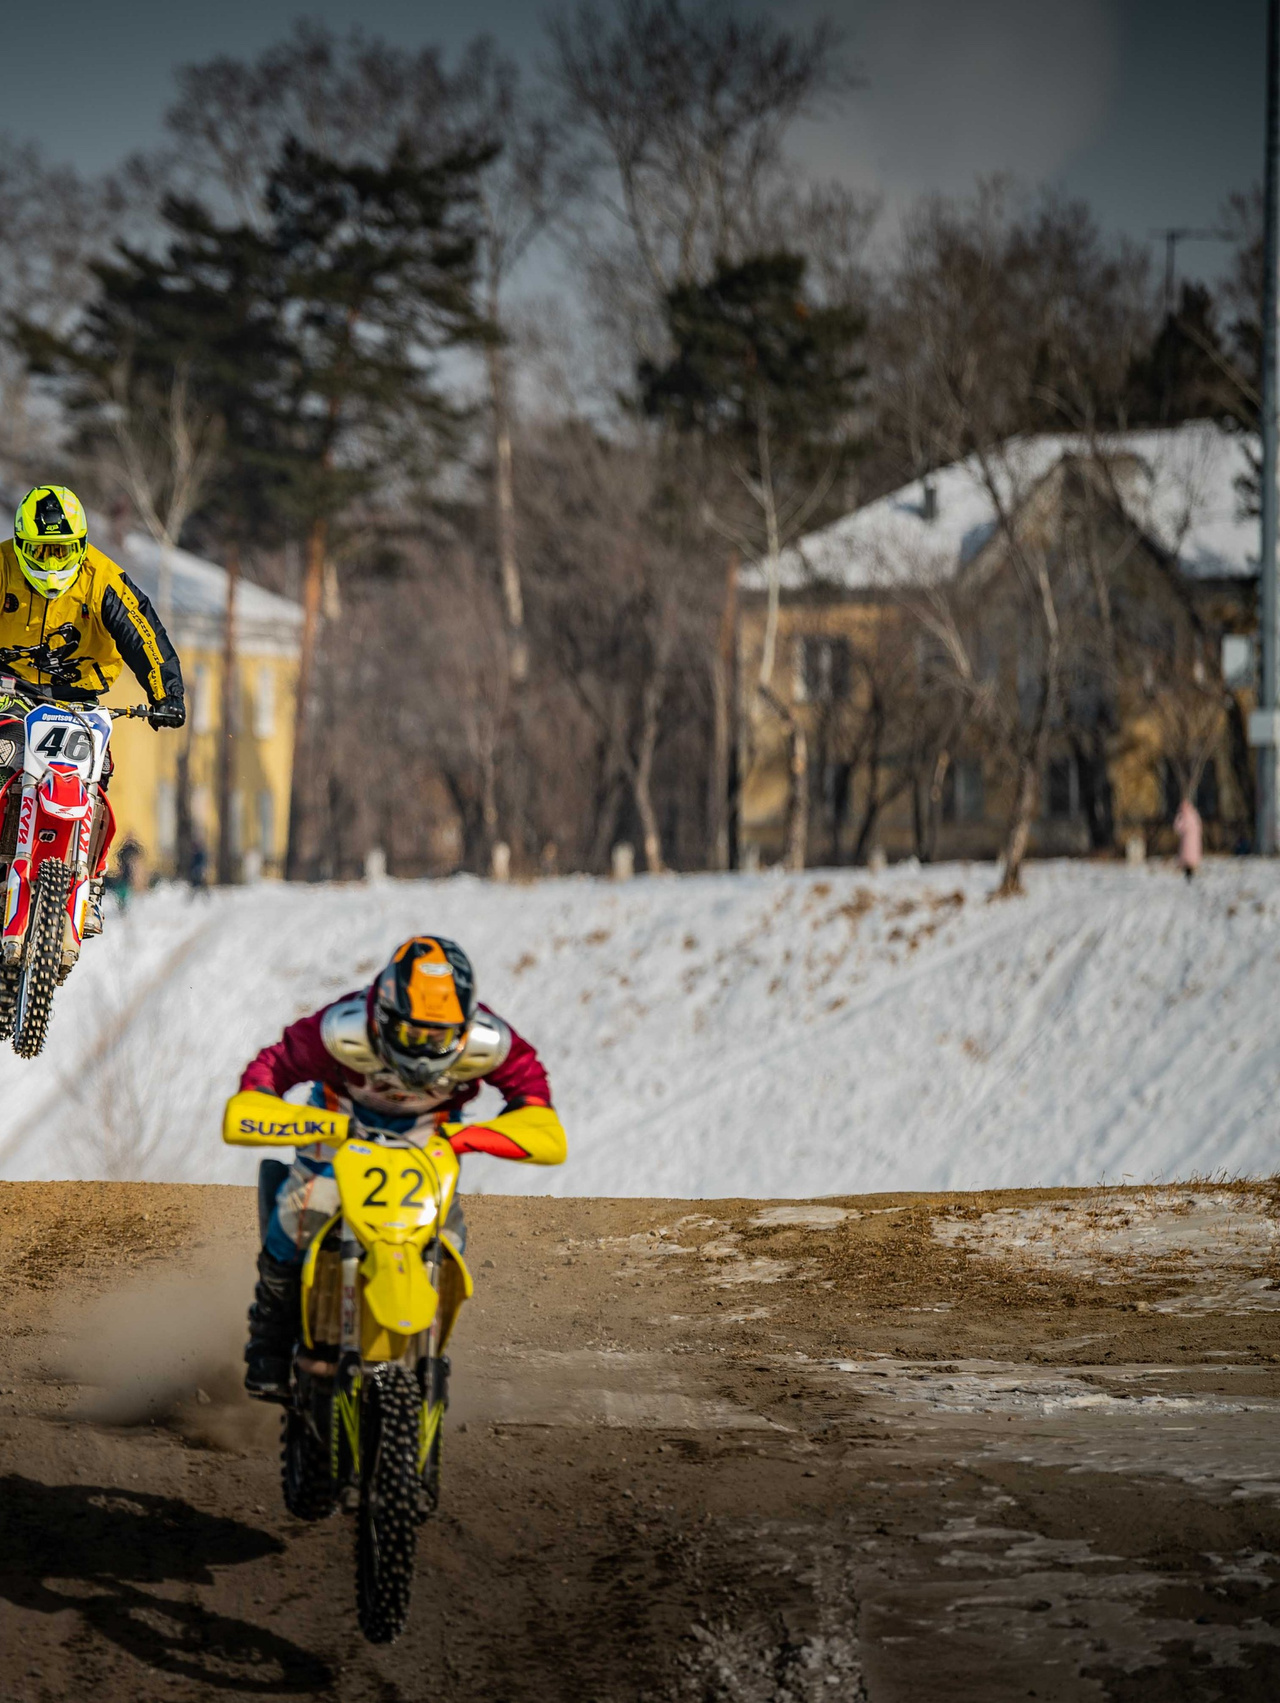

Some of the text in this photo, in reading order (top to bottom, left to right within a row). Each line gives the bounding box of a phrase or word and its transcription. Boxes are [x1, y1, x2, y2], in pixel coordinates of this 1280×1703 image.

[42, 713, 73, 722] Ogurtsov
[35, 726, 92, 761] 46
[40, 833, 54, 842] 46
[239, 1119, 336, 1136] SUZUKI
[362, 1167, 425, 1208] 22
